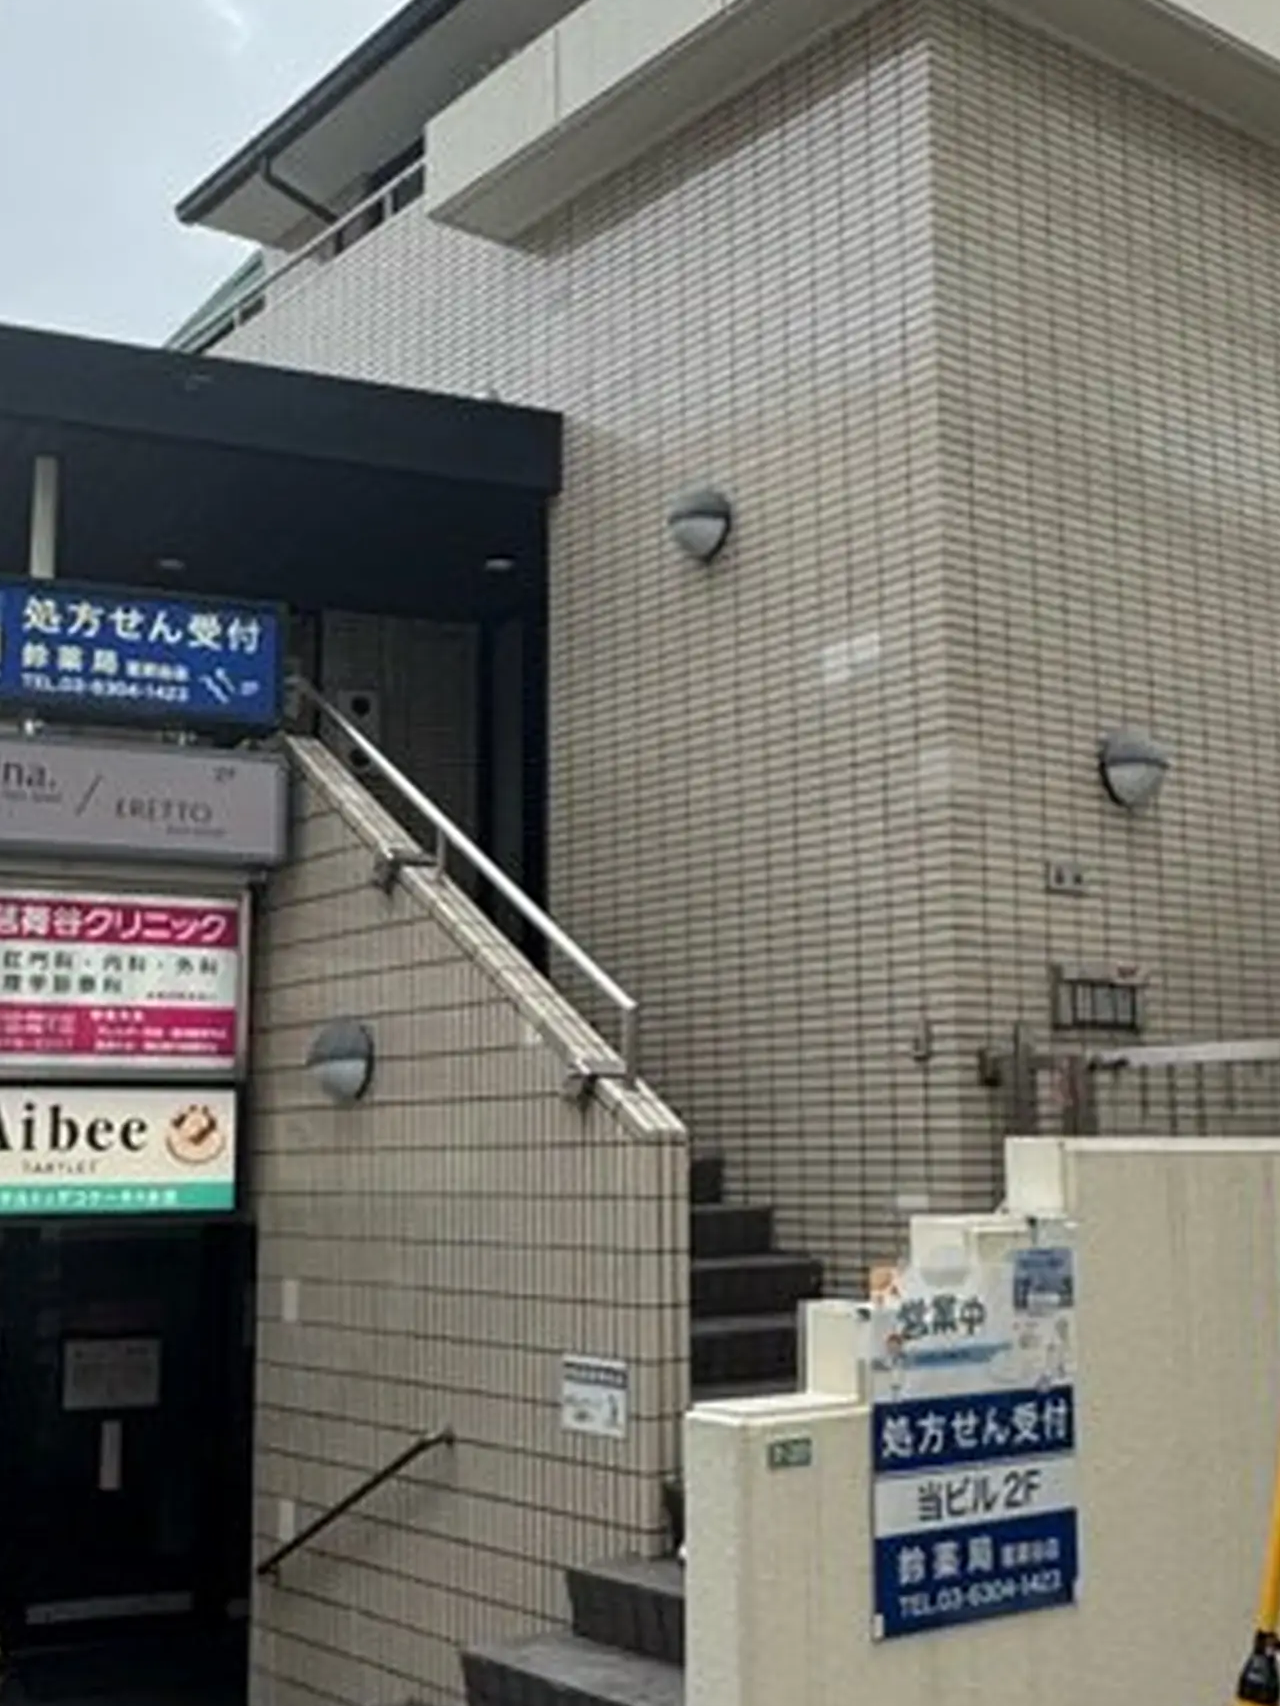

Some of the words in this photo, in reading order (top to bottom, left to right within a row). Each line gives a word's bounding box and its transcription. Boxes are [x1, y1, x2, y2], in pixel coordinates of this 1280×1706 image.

[22, 596, 262, 654] 処方せん受付
[897, 1294, 987, 1340] 営業中
[882, 1398, 1068, 1458] 処方せん受付
